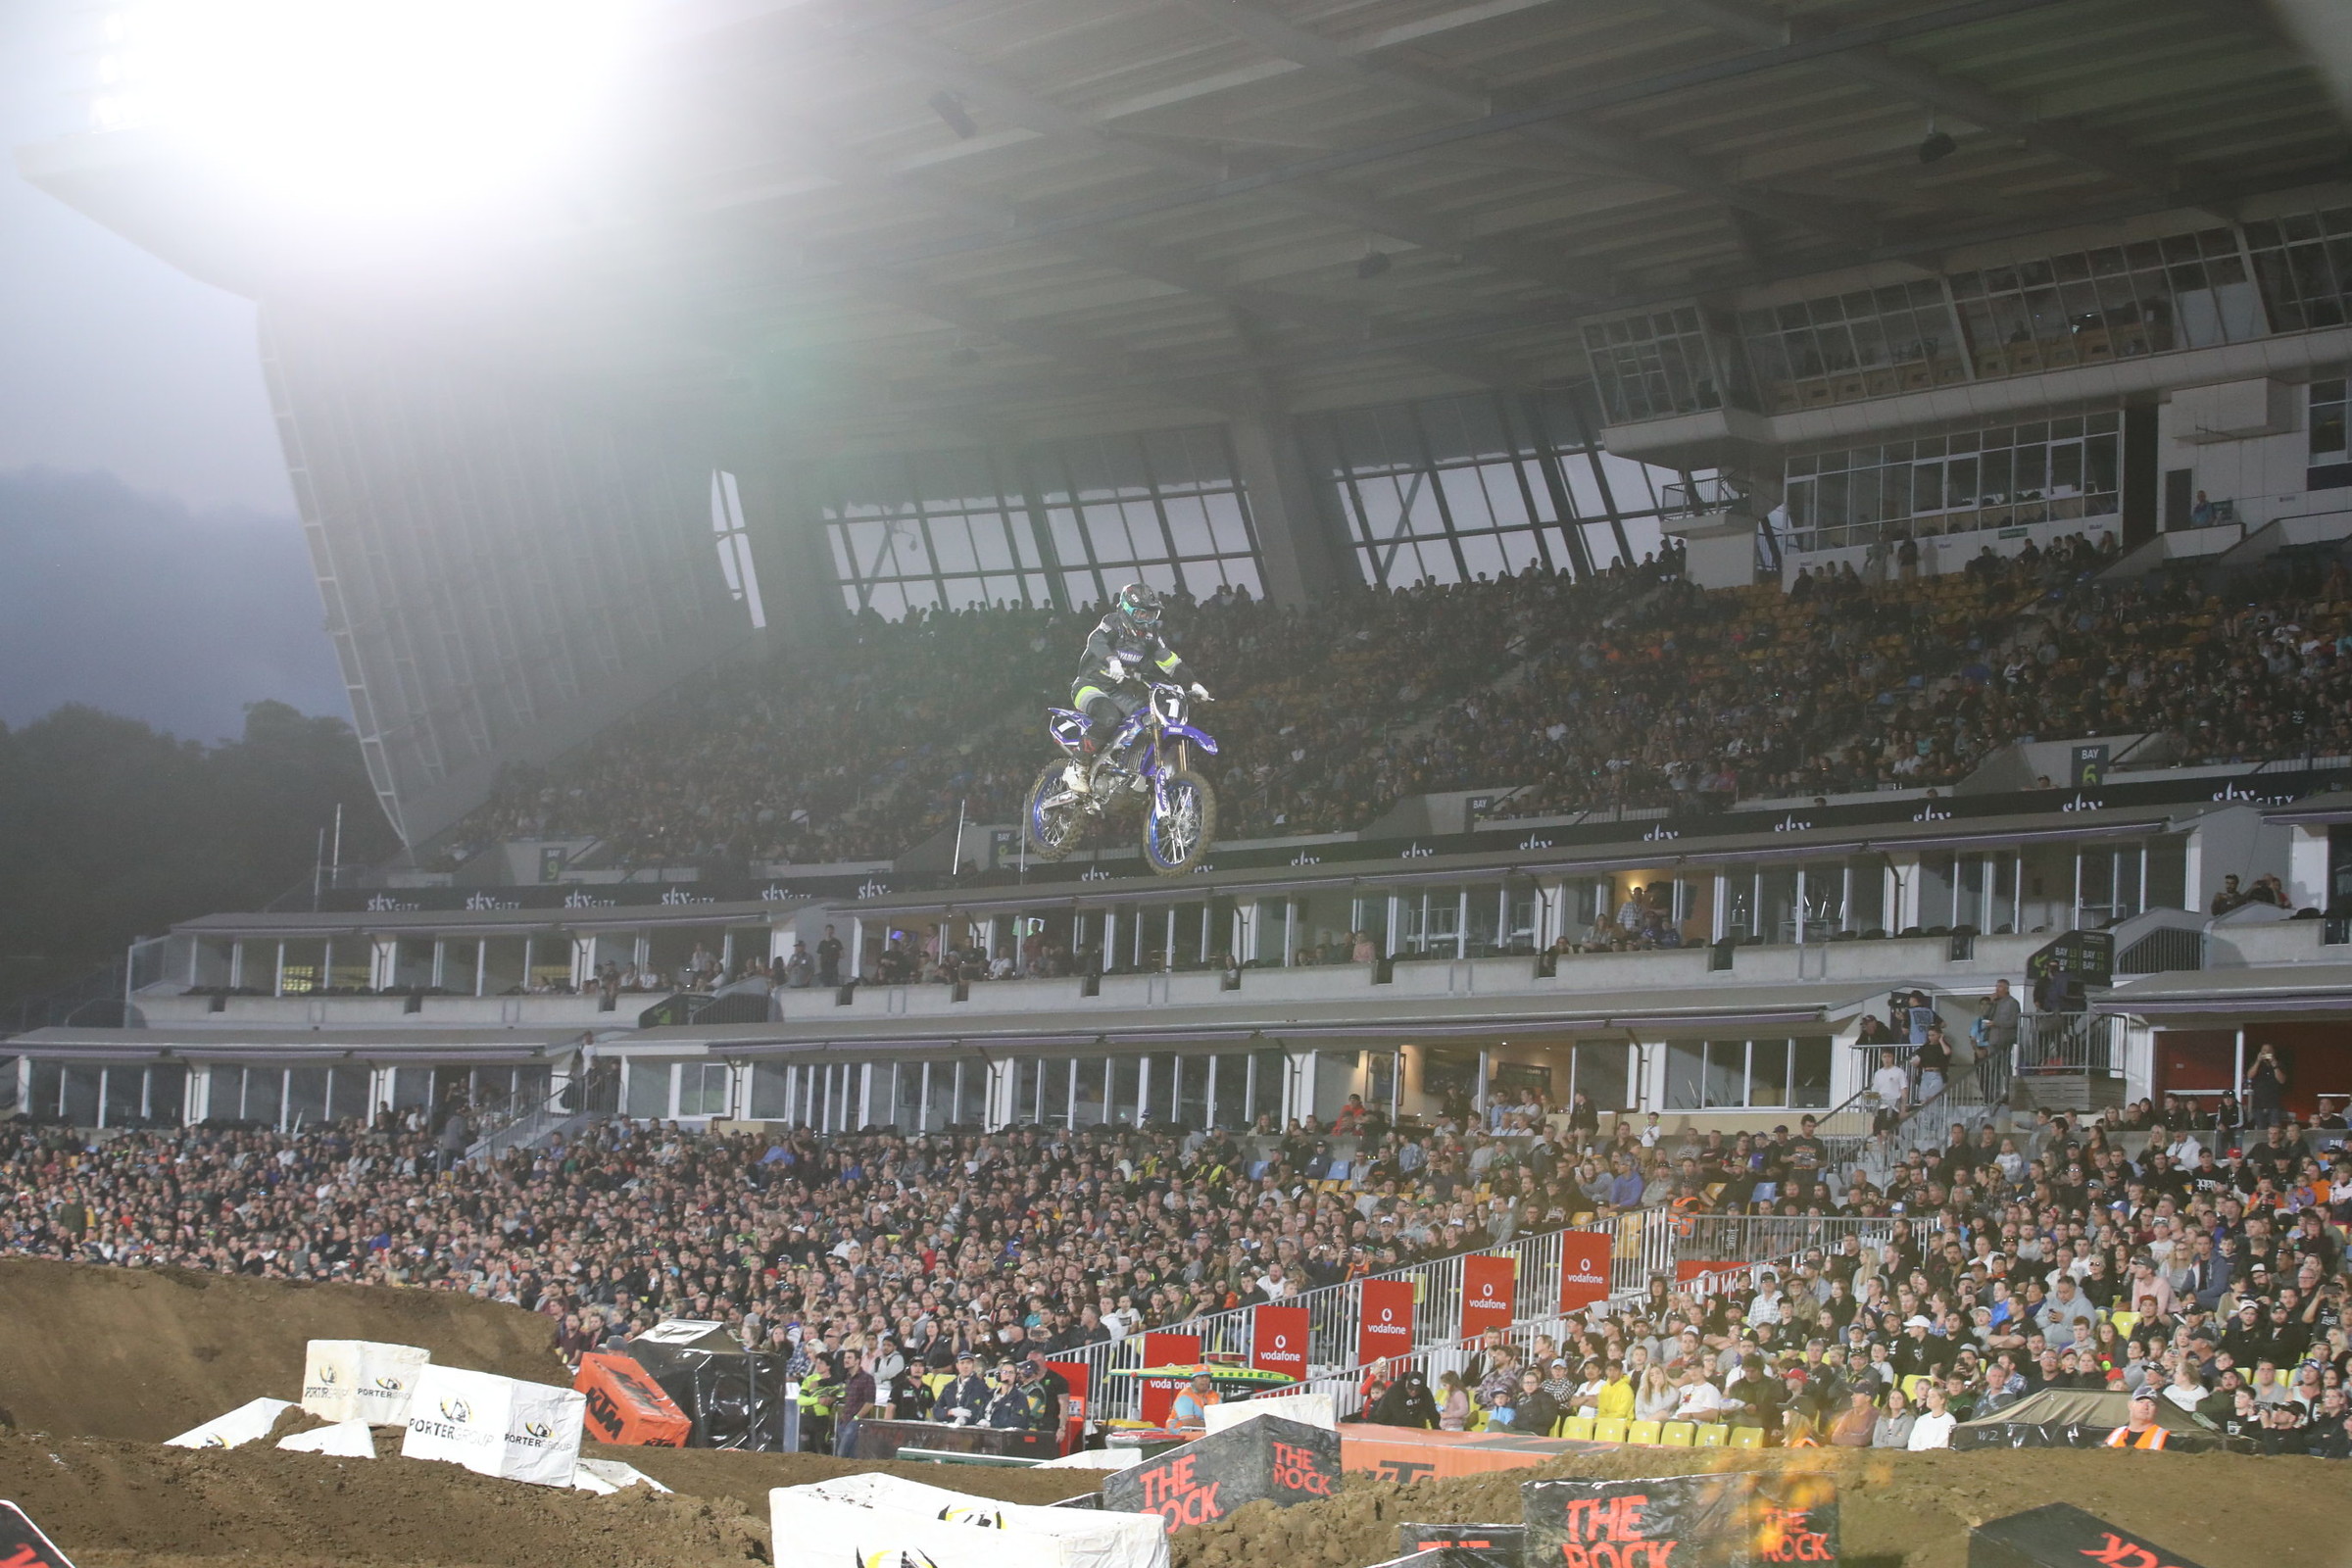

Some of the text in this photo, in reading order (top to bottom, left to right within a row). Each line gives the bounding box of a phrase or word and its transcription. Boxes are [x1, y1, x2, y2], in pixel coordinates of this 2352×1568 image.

[1166, 698, 1180, 718] 1
[1057, 719, 1076, 733] 1
[2082, 749, 2099, 760] BAY
[2082, 764, 2097, 784] 6
[1473, 799, 1488, 809] BAY
[998, 833, 1011, 842] BAY
[547, 861, 559, 880] 9
[2055, 947, 2068, 956] BAY
[2082, 950, 2095, 959] BAY
[2082, 960, 2095, 970] BAY
[1567, 1273, 1603, 1284] vodafone
[1469, 1298, 1506, 1310] vodafone
[1367, 1323, 1406, 1335] vodafone
[1260, 1350, 1300, 1362] vodafone
[1150, 1379, 1191, 1390] vodaone
[586, 1387, 624, 1441] KTM
[1978, 1430, 2000, 1442] W2
[1272, 1442, 1316, 1471] THE
[1139, 1453, 1197, 1507] THE
[1273, 1463, 1333, 1495] ROCK
[1140, 1481, 1225, 1534] OCK
[1566, 1494, 1648, 1544] THE
[1762, 1507, 1811, 1534] THE
[1761, 1533, 1835, 1562] ROCK
